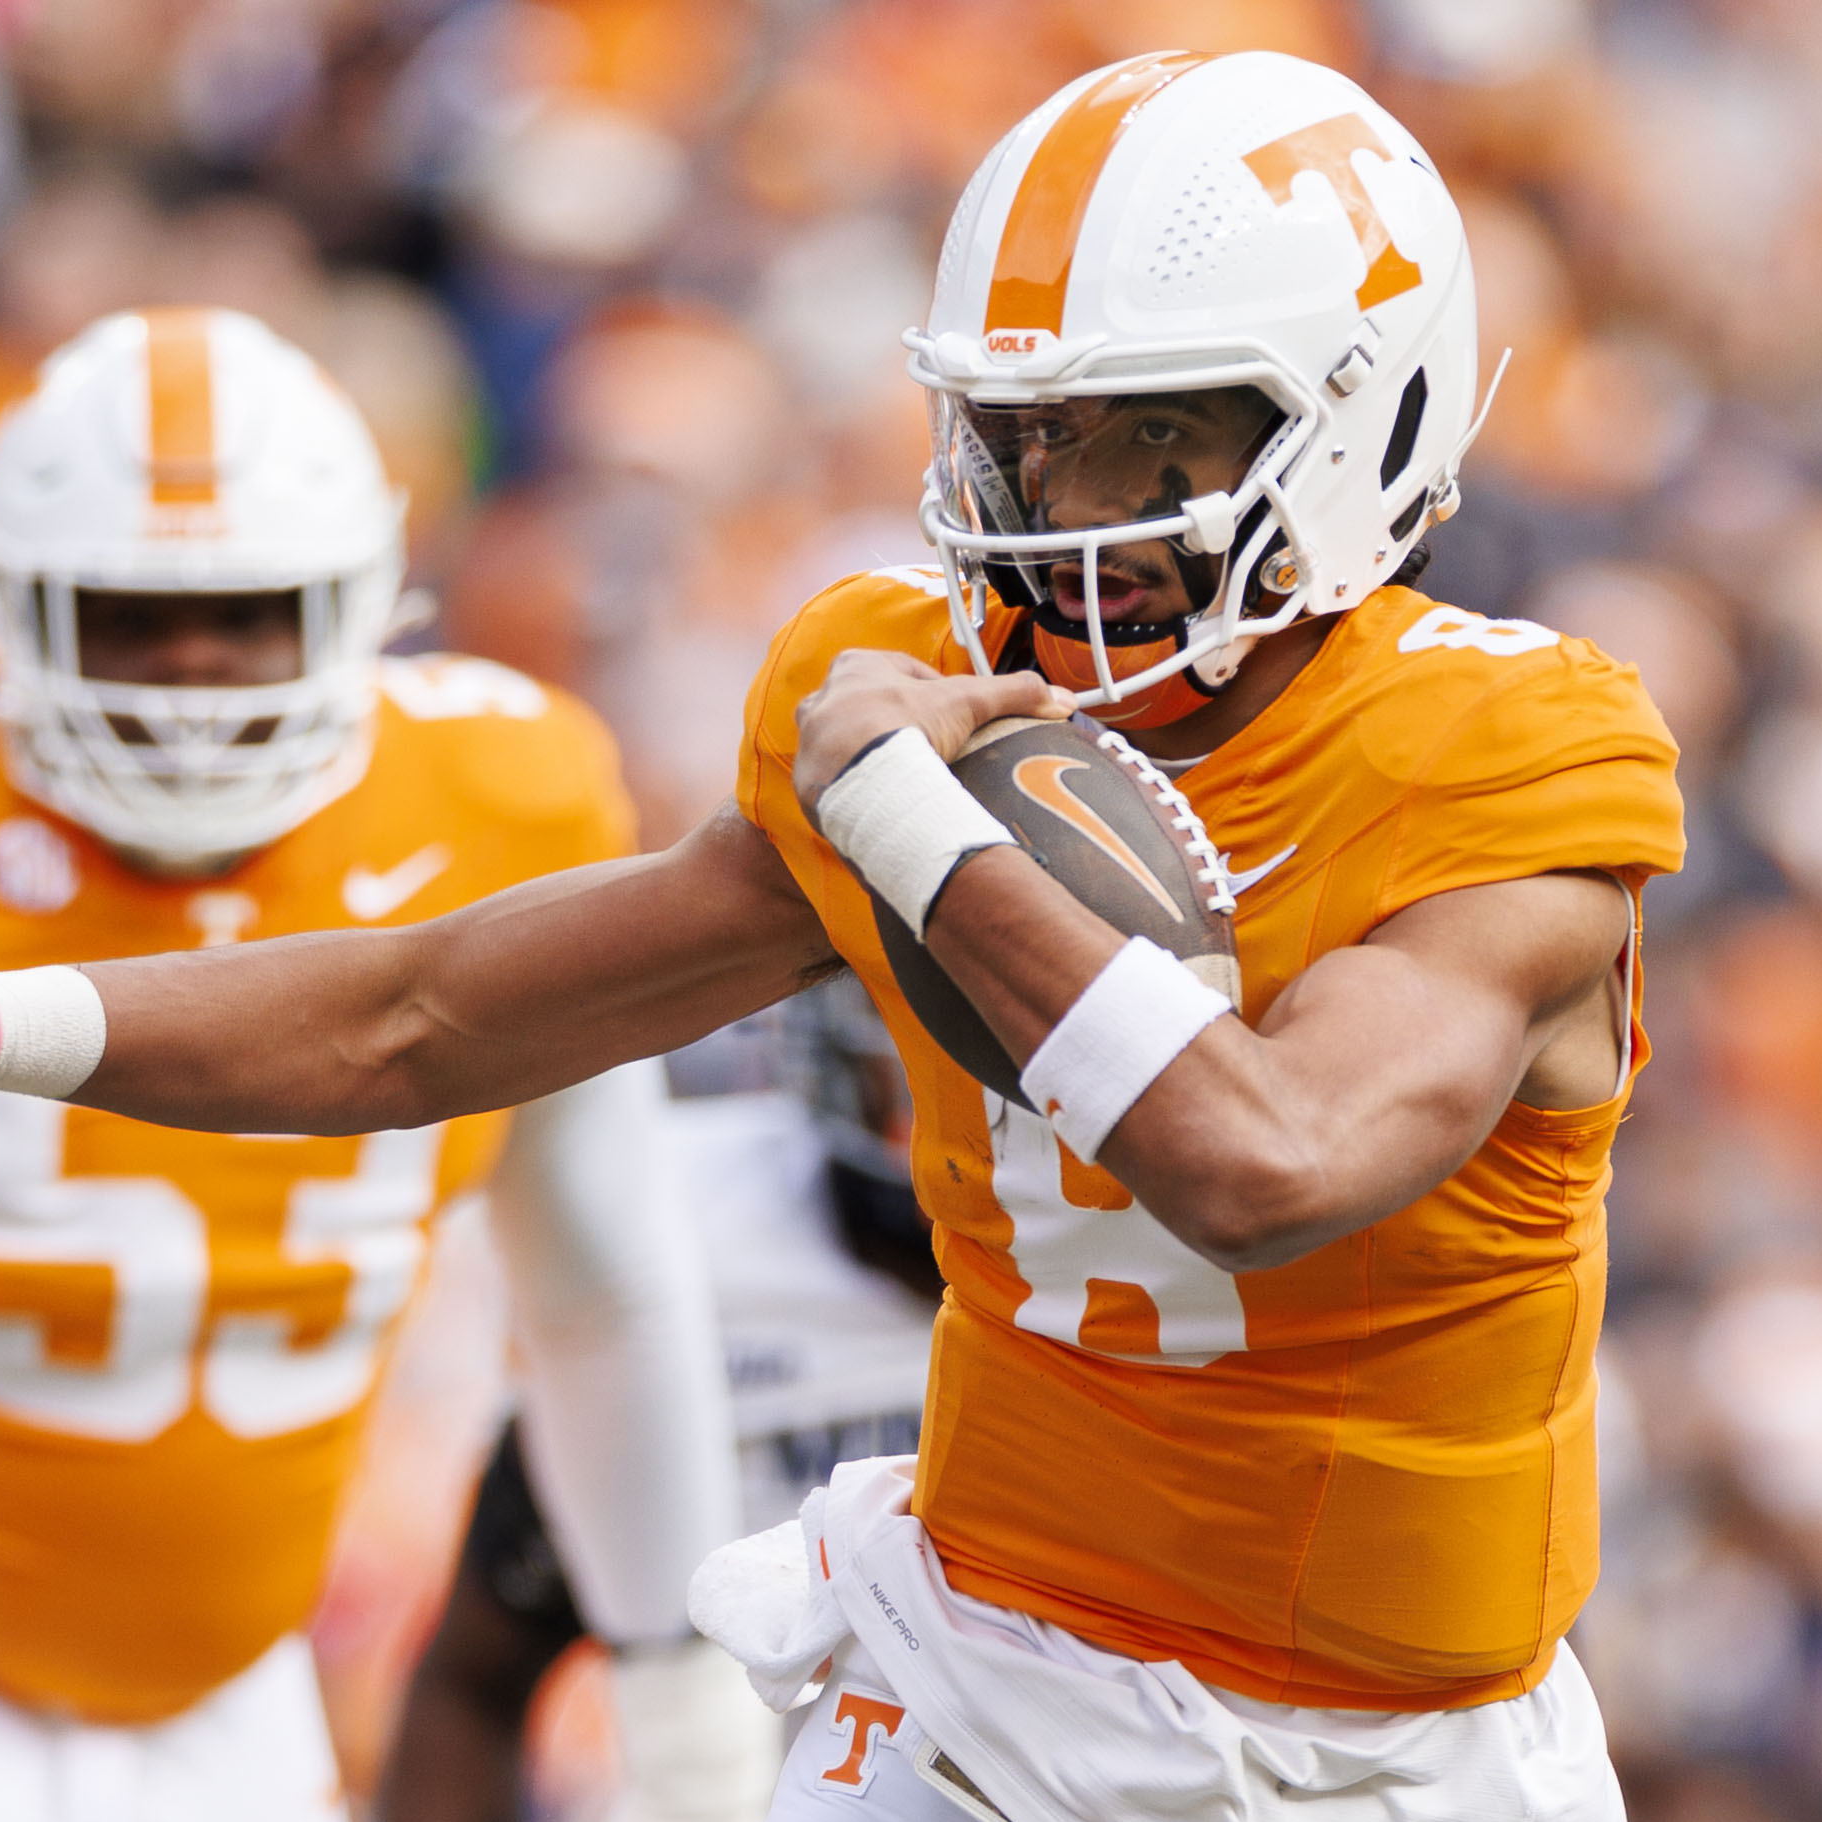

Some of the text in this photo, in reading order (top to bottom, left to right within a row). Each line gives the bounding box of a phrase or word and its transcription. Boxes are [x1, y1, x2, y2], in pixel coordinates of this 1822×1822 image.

[1240, 111, 1423, 312] T
[988, 336, 1036, 352] VOLS
[1397, 606, 1561, 657] 8
[869, 1582, 920, 1651] NIKE PRO
[821, 1691, 906, 1787] T
